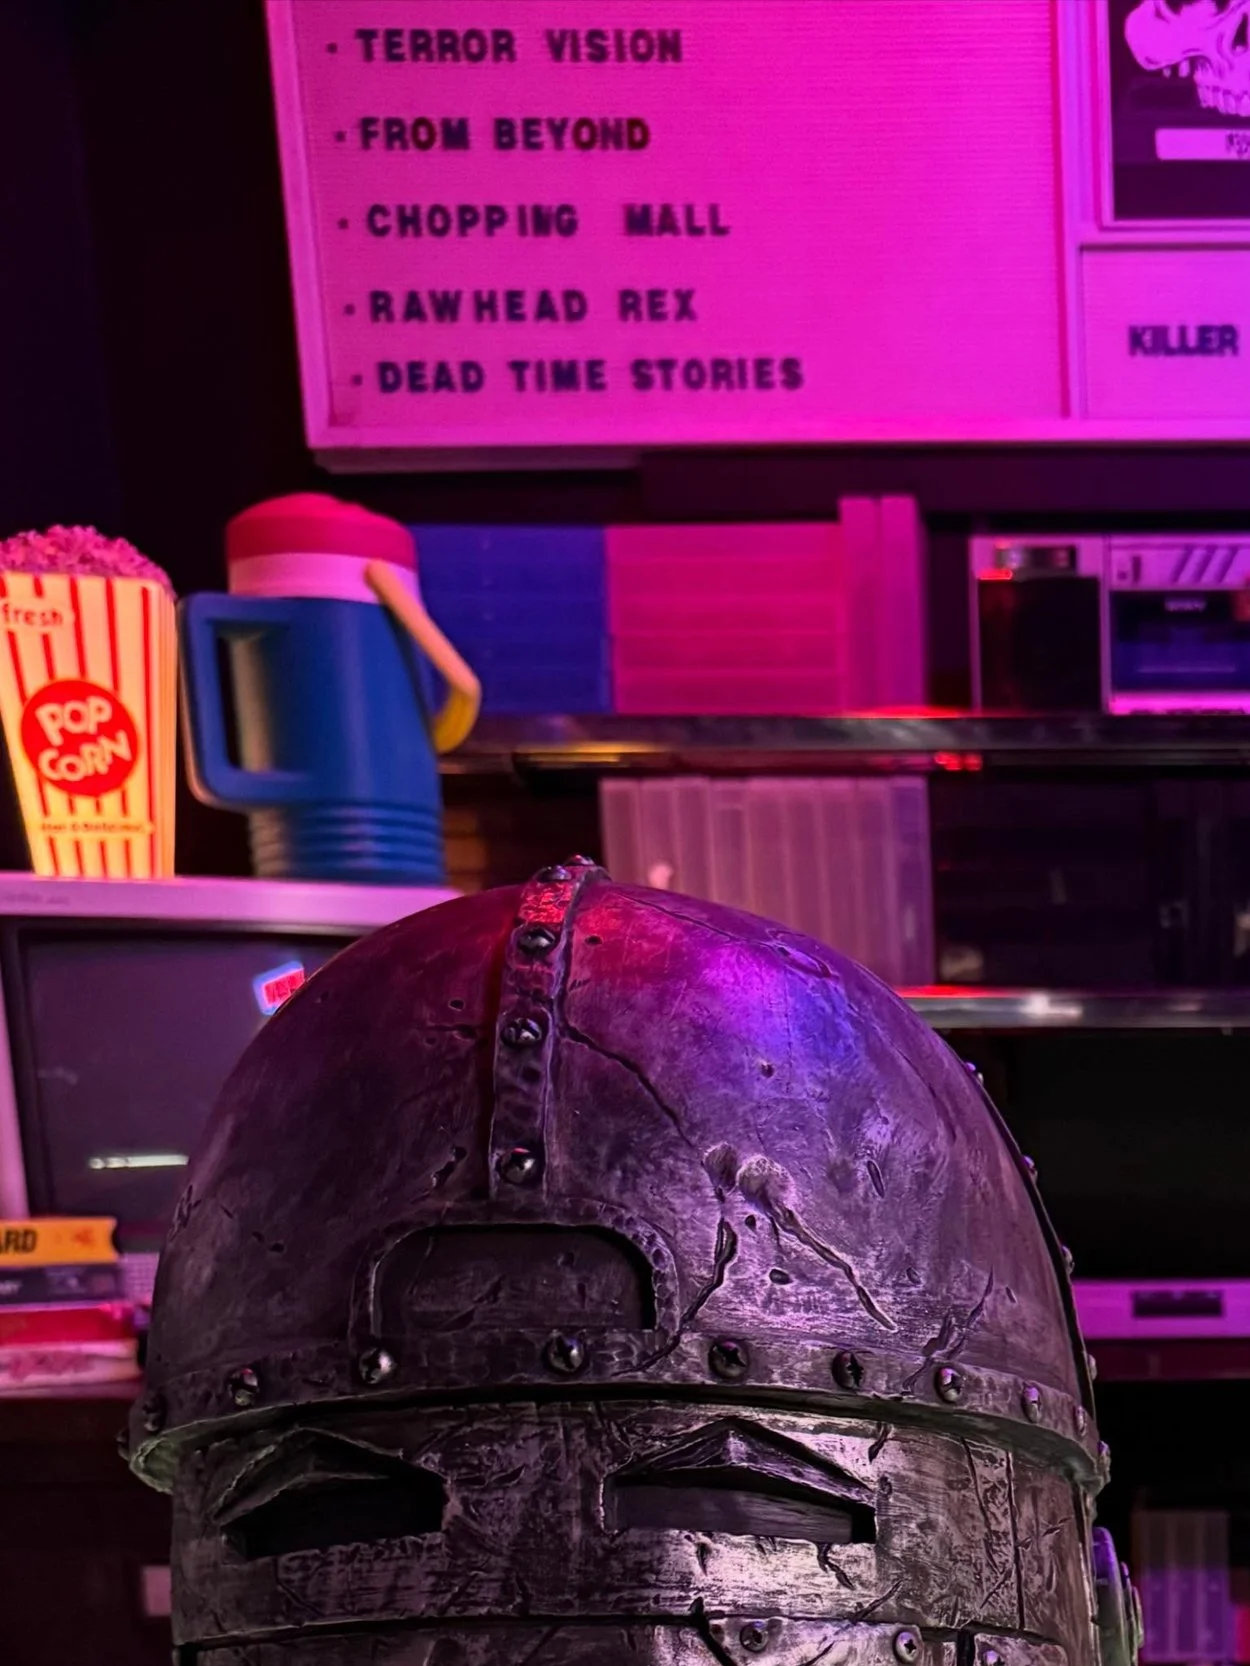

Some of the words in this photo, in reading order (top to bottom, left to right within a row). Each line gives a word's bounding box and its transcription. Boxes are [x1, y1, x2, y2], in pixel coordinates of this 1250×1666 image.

[356, 29, 517, 64] TERROR
[544, 28, 684, 63] VISION
[358, 118, 470, 151] FROM
[494, 117, 651, 151] BEYOND
[366, 204, 579, 239] CHOPPING
[624, 203, 731, 237] MALL
[369, 289, 589, 324] RAWHEAD
[617, 289, 698, 323] REX
[1128, 324, 1238, 357] KILLER
[376, 361, 485, 394] DEAD
[508, 360, 607, 393] TIME
[630, 358, 804, 391] STORIES
[35, 696, 112, 746] POP
[38, 729, 132, 781] CORN
[0, 1228, 37, 1254] RD
